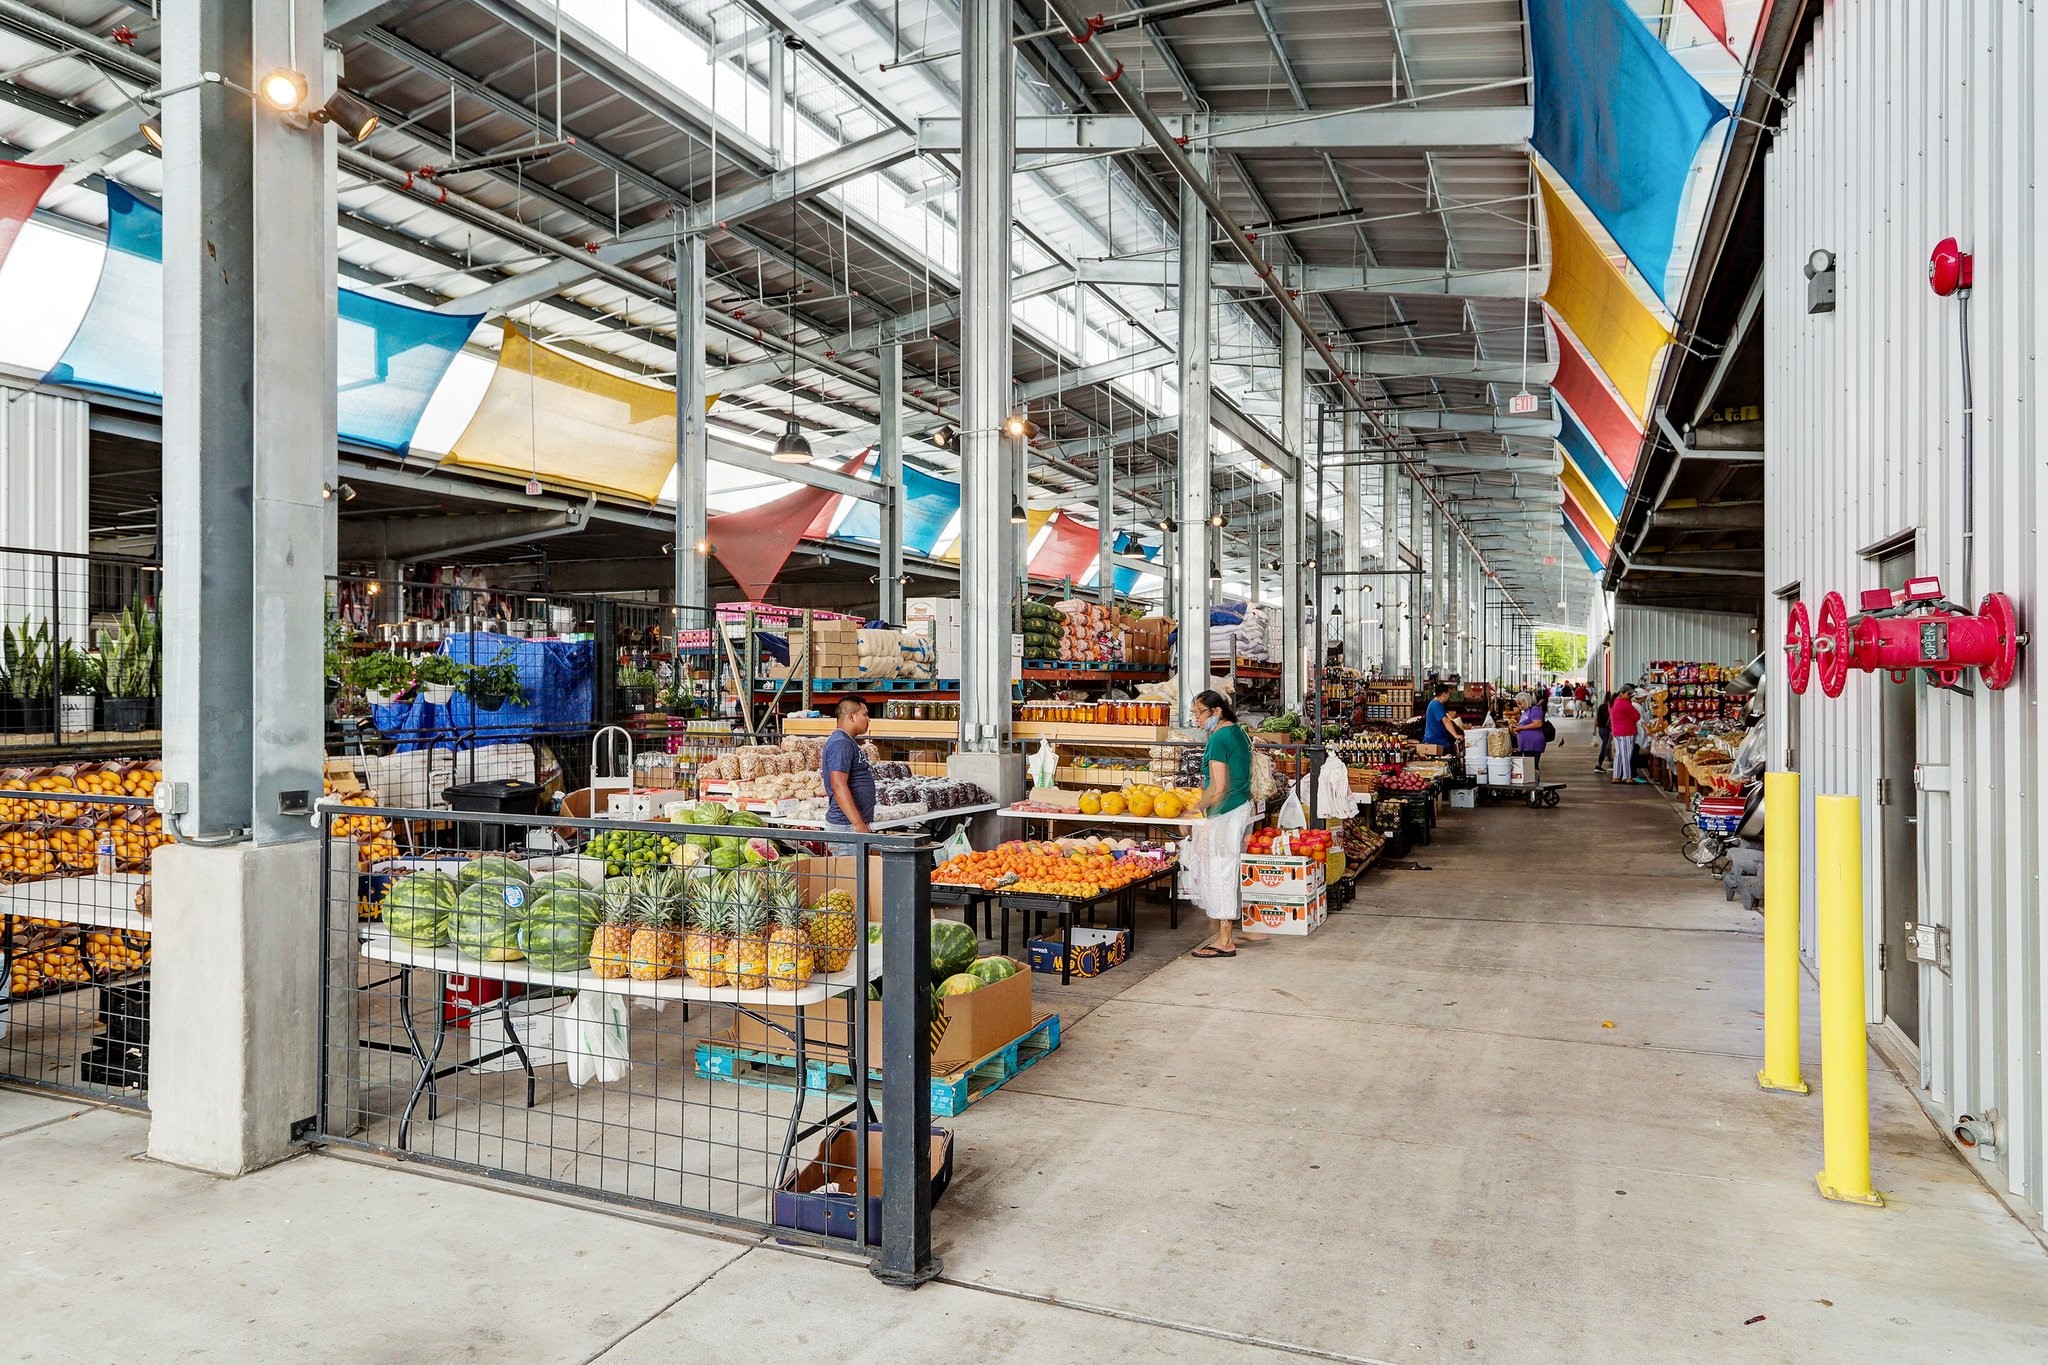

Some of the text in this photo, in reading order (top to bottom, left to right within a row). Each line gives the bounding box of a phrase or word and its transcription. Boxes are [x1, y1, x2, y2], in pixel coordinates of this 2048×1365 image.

[1514, 397, 1534, 411] EXIT
[528, 483, 538, 494] EXIT
[1924, 625, 1936, 656] OPEN
